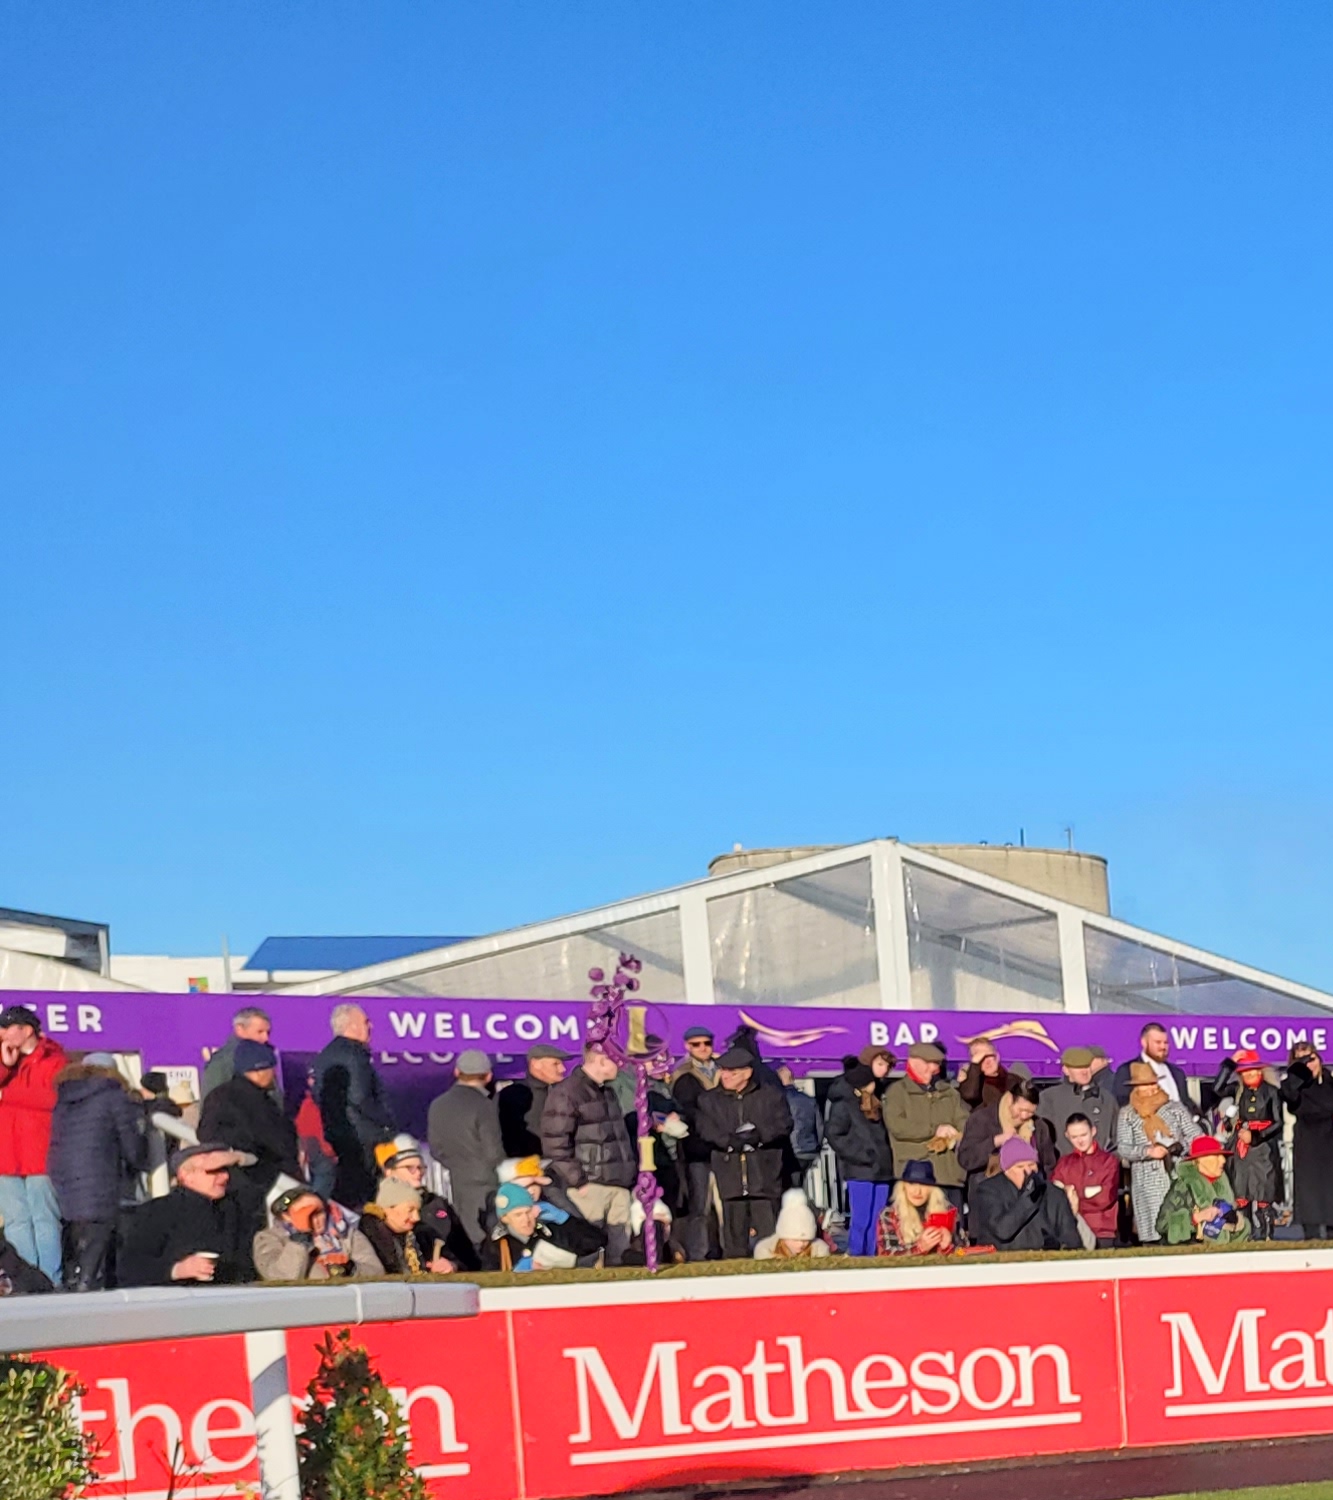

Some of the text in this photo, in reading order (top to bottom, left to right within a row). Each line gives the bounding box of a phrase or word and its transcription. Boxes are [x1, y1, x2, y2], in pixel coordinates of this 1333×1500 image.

[388, 1010, 596, 1041] WELCOM
[870, 1021, 939, 1047] BAR
[1171, 1027, 1328, 1051] WELCOME
[562, 1335, 1082, 1443] Matheson
